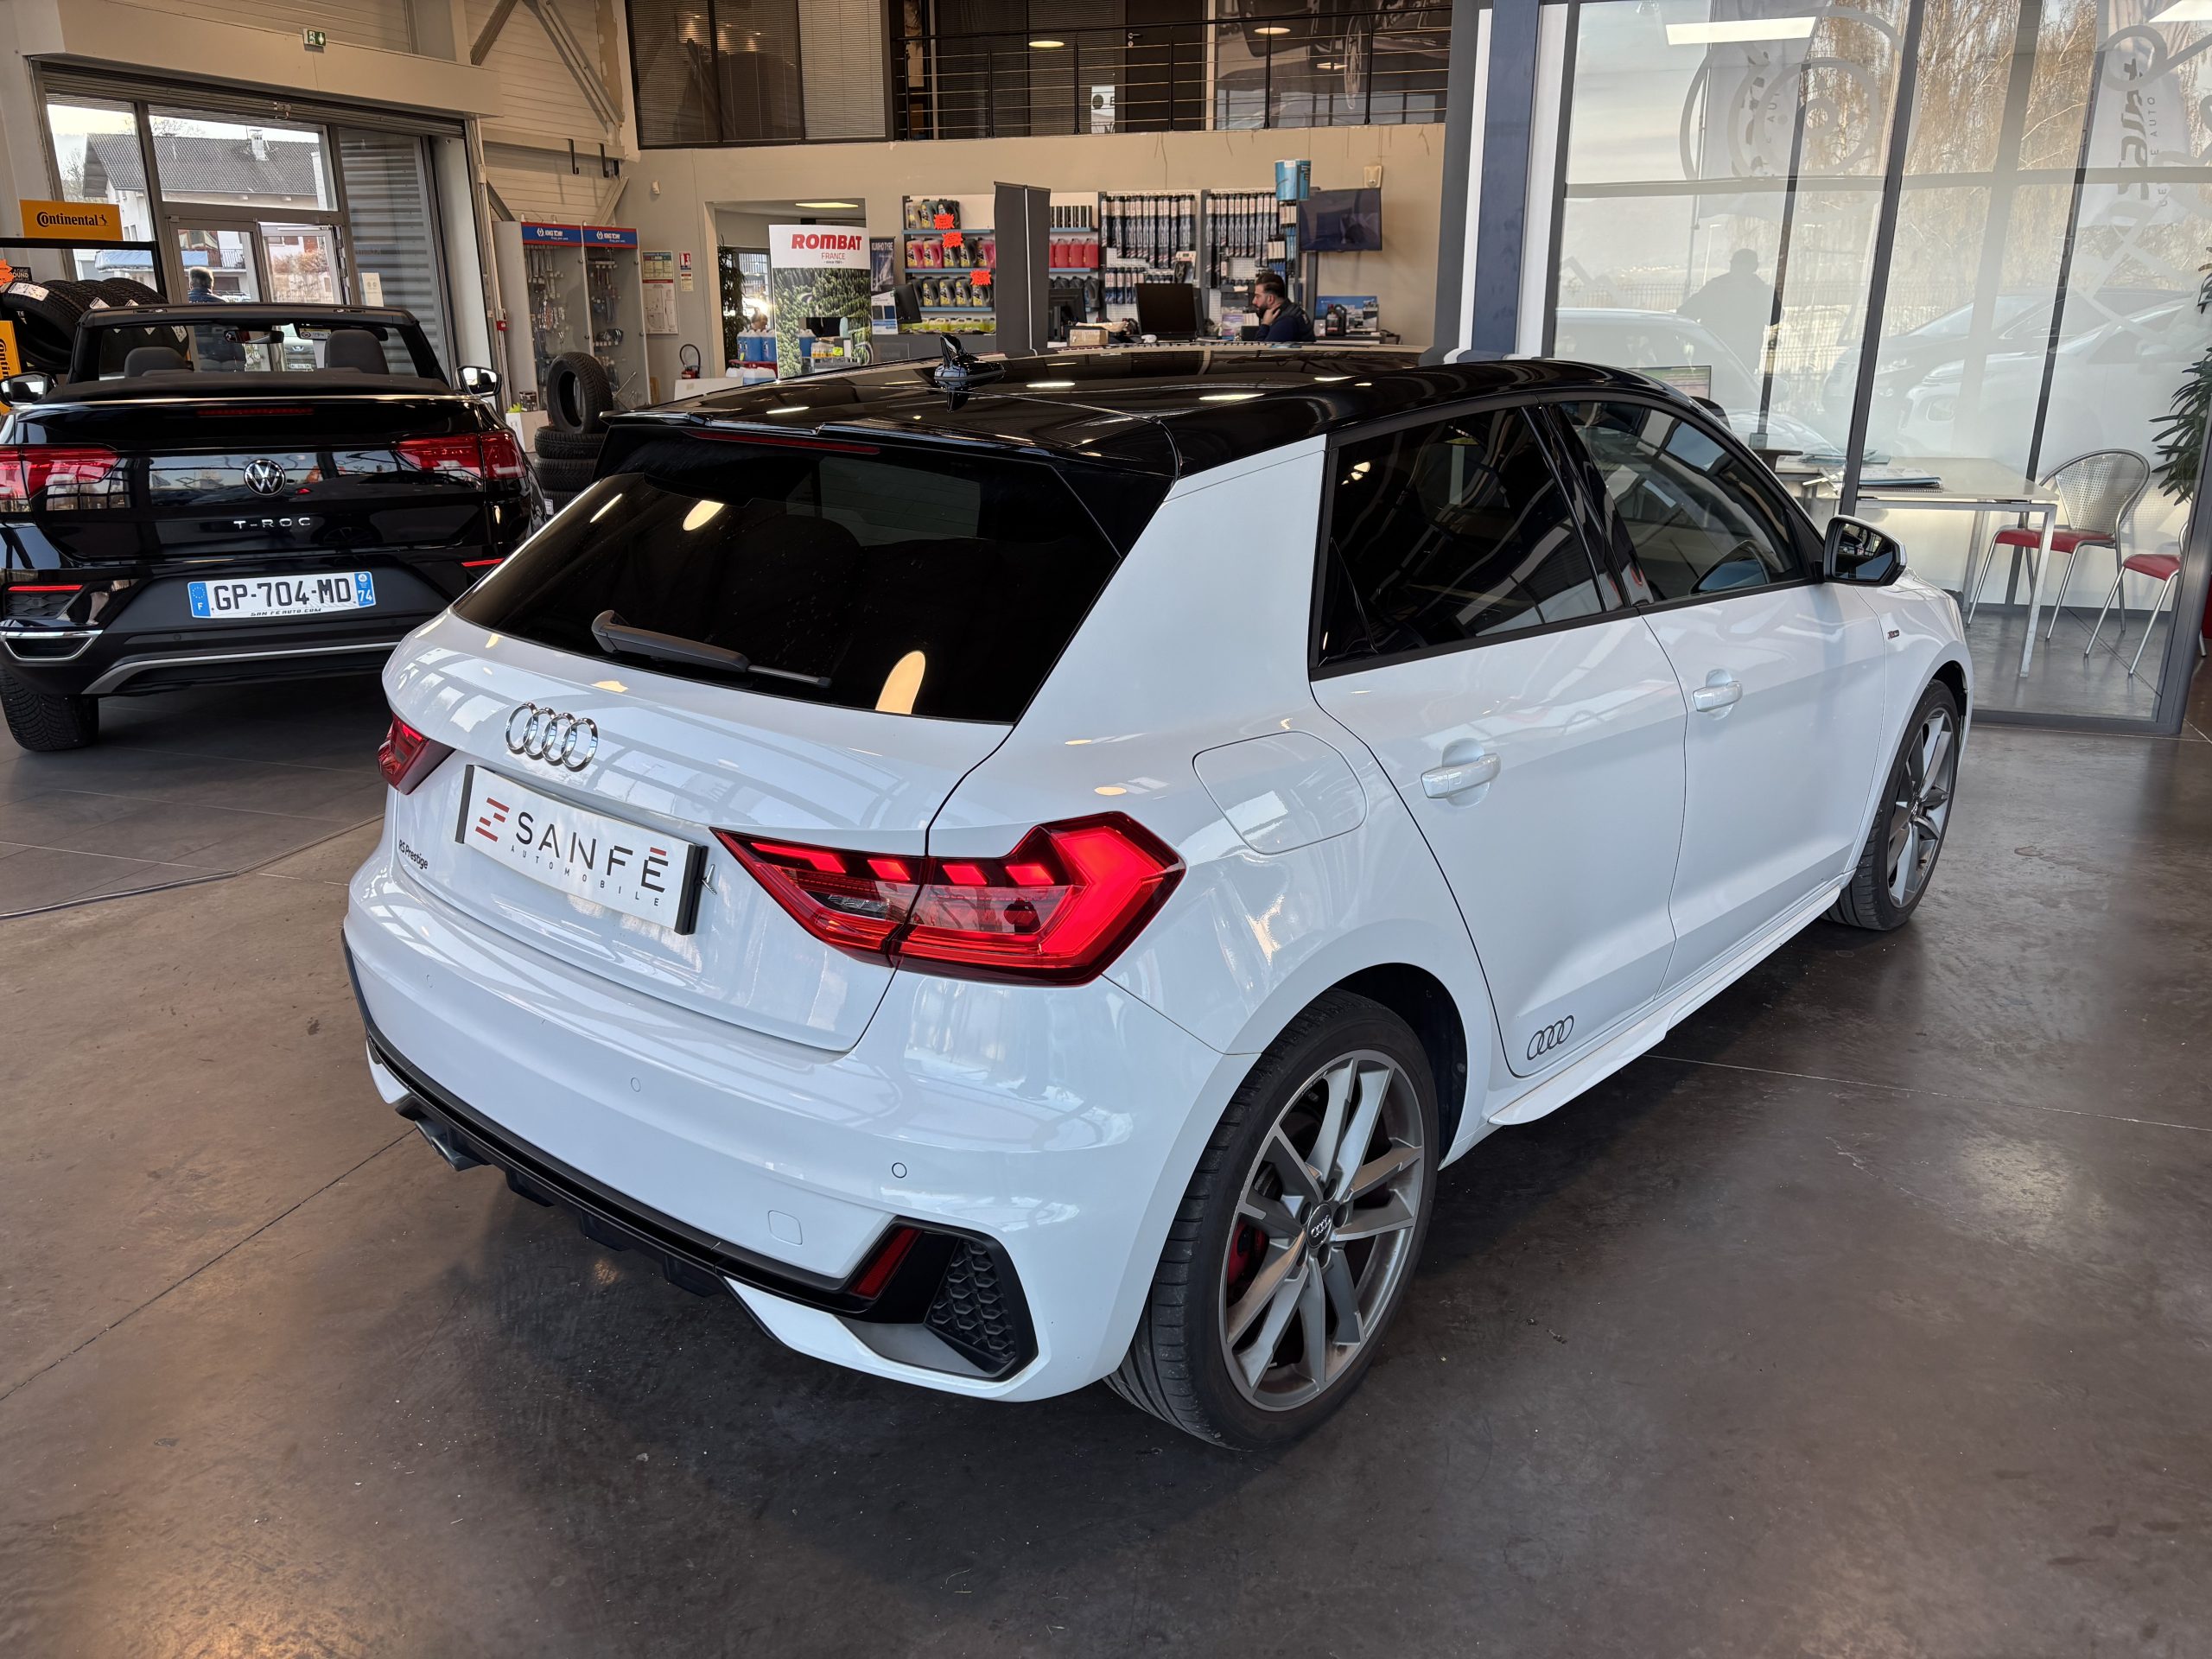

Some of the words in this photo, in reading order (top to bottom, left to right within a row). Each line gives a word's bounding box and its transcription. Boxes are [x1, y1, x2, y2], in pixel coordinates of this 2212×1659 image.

[2146, 96, 2159, 138] AUTO
[36, 211, 99, 228] Continental
[791, 233, 862, 251] ROMBAT
[821, 251, 846, 260] FRANCE
[232, 517, 311, 530] T-ROC
[197, 601, 203, 611] F
[213, 578, 352, 611] GP-704-MD
[357, 588, 372, 602] 74
[404, 843, 429, 870] Prestige
[510, 844, 660, 907] AUTOMOBILE
